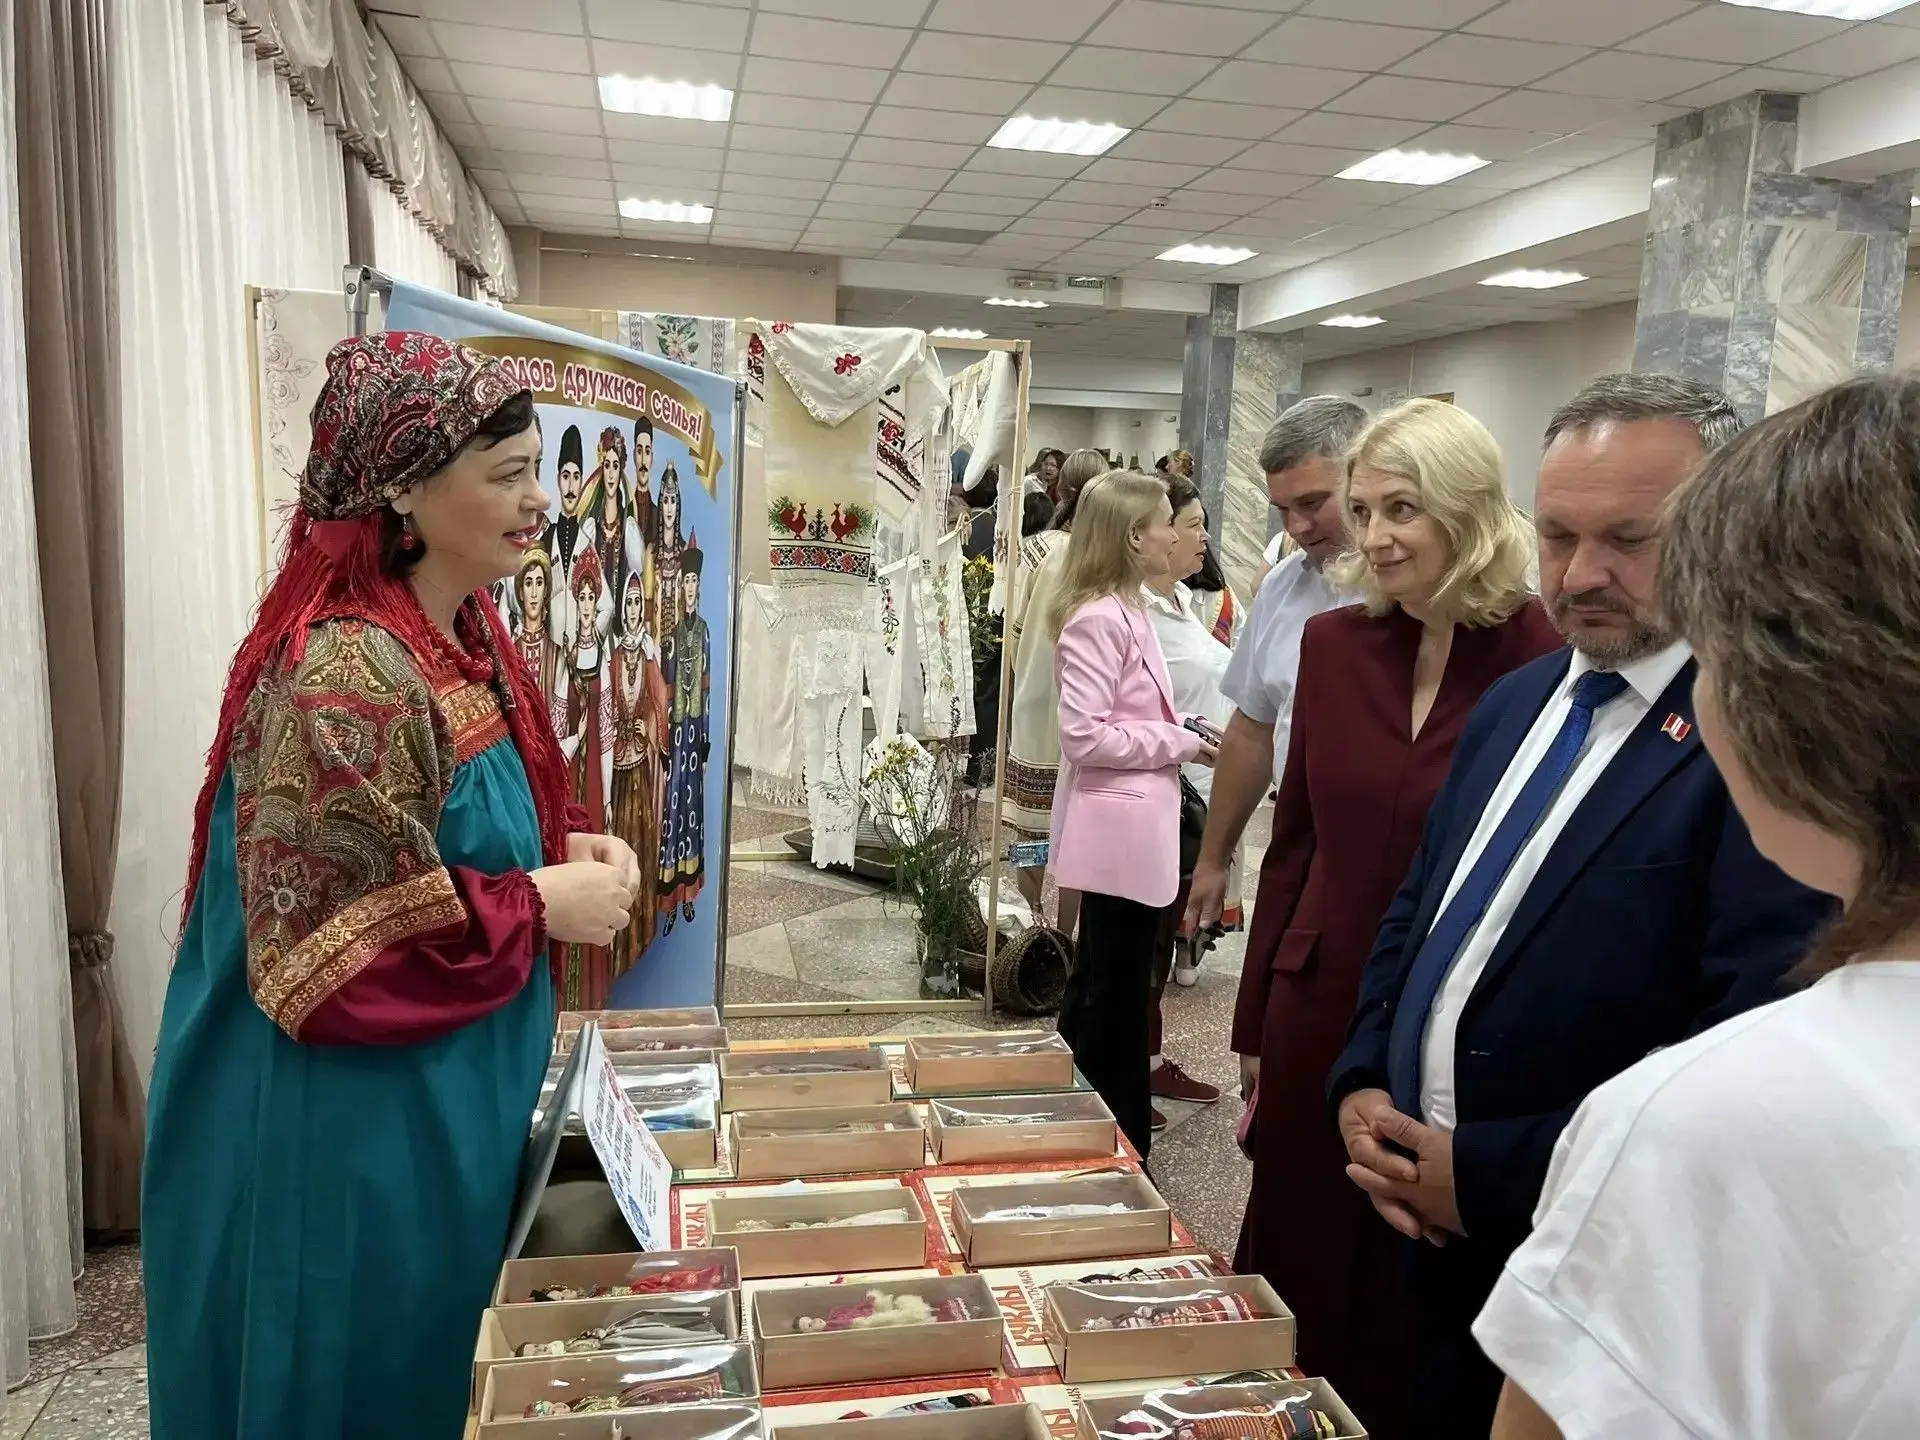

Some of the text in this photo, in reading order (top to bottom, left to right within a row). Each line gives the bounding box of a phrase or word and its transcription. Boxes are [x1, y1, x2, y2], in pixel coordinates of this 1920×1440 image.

[500, 356, 704, 444] одов дружная семья!
[990, 1285, 1045, 1347] КУКЛЫ
